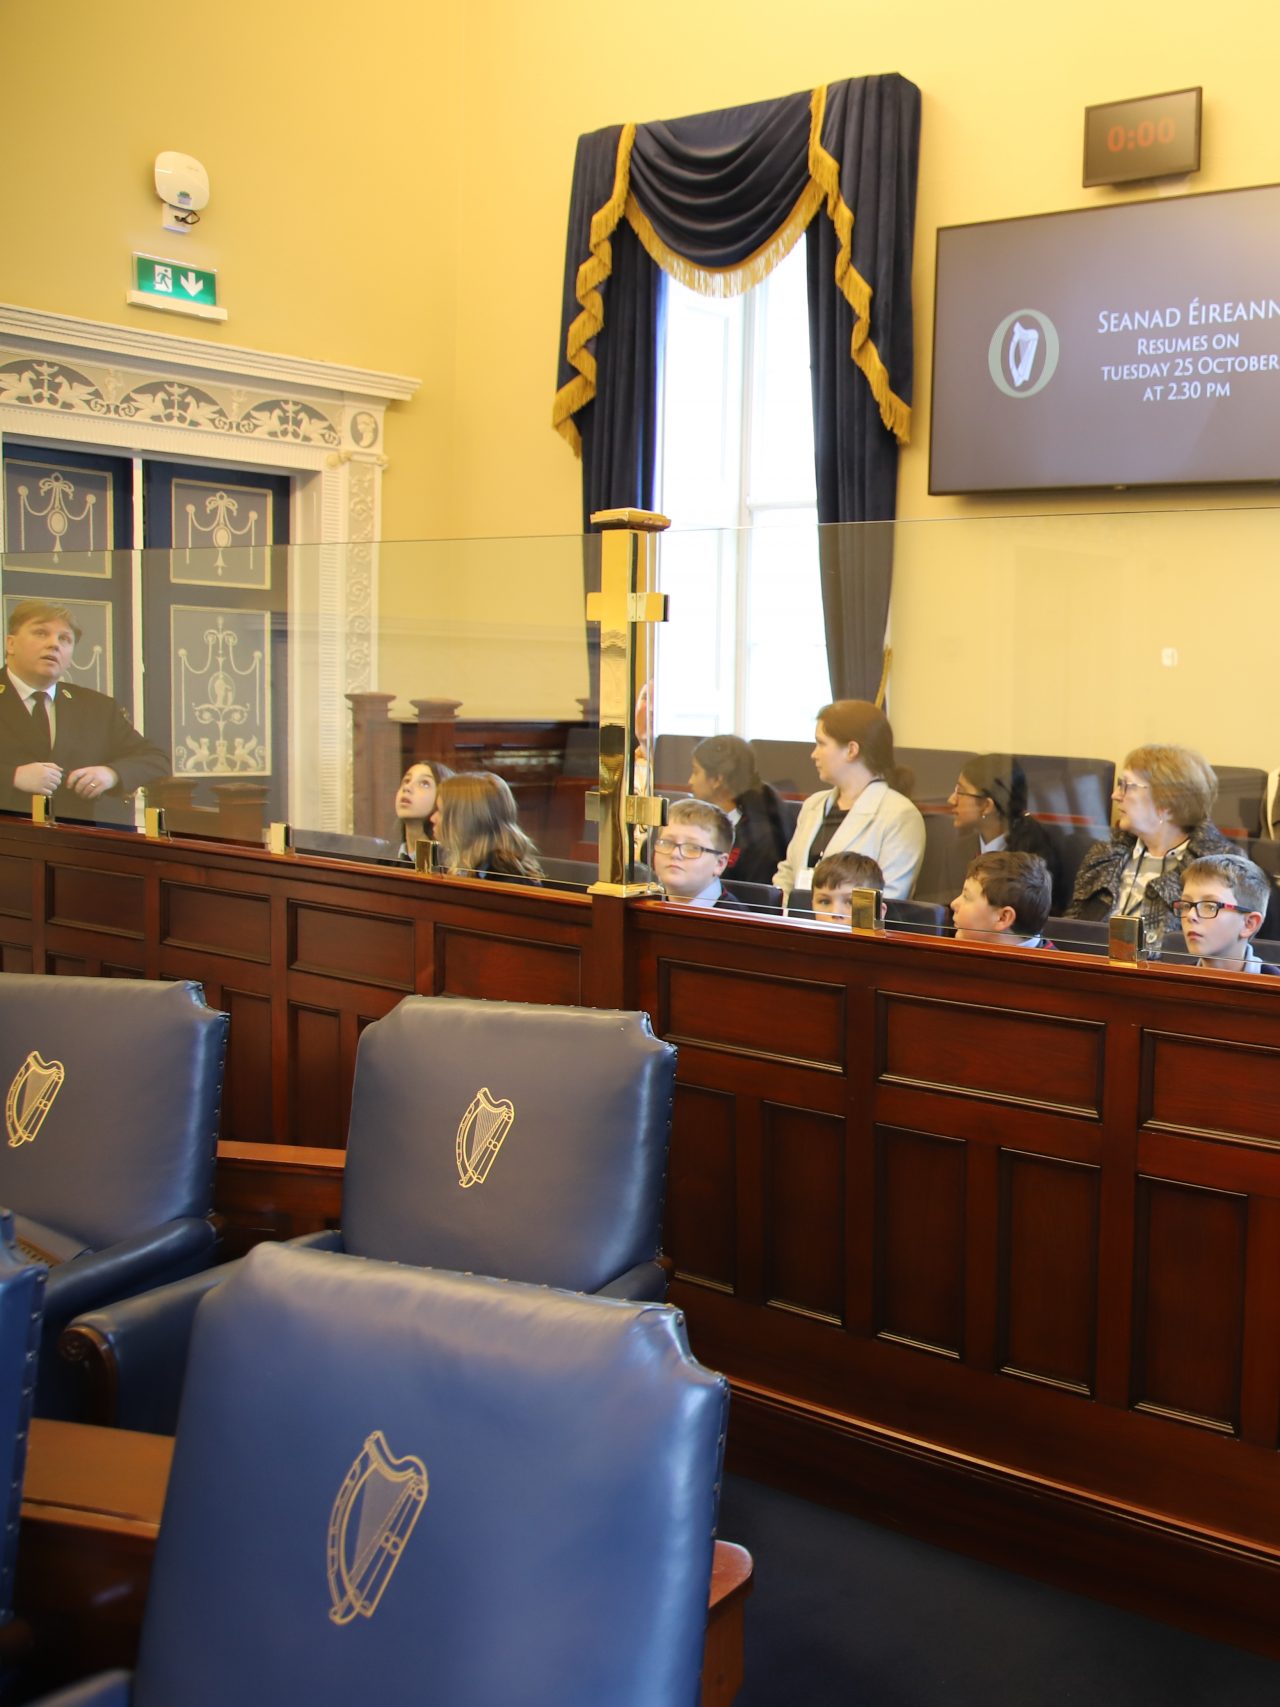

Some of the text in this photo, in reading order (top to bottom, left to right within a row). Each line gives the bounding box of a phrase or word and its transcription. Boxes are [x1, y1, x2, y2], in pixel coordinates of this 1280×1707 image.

[1106, 117, 1176, 153] 0:00
[1098, 310, 1181, 334] SEANAD
[1137, 333, 1240, 356] RESUMES ON
[1101, 355, 1280, 381] TUESDAY 25 OCTOBER
[1143, 381, 1231, 402] AT 2.30 PM
